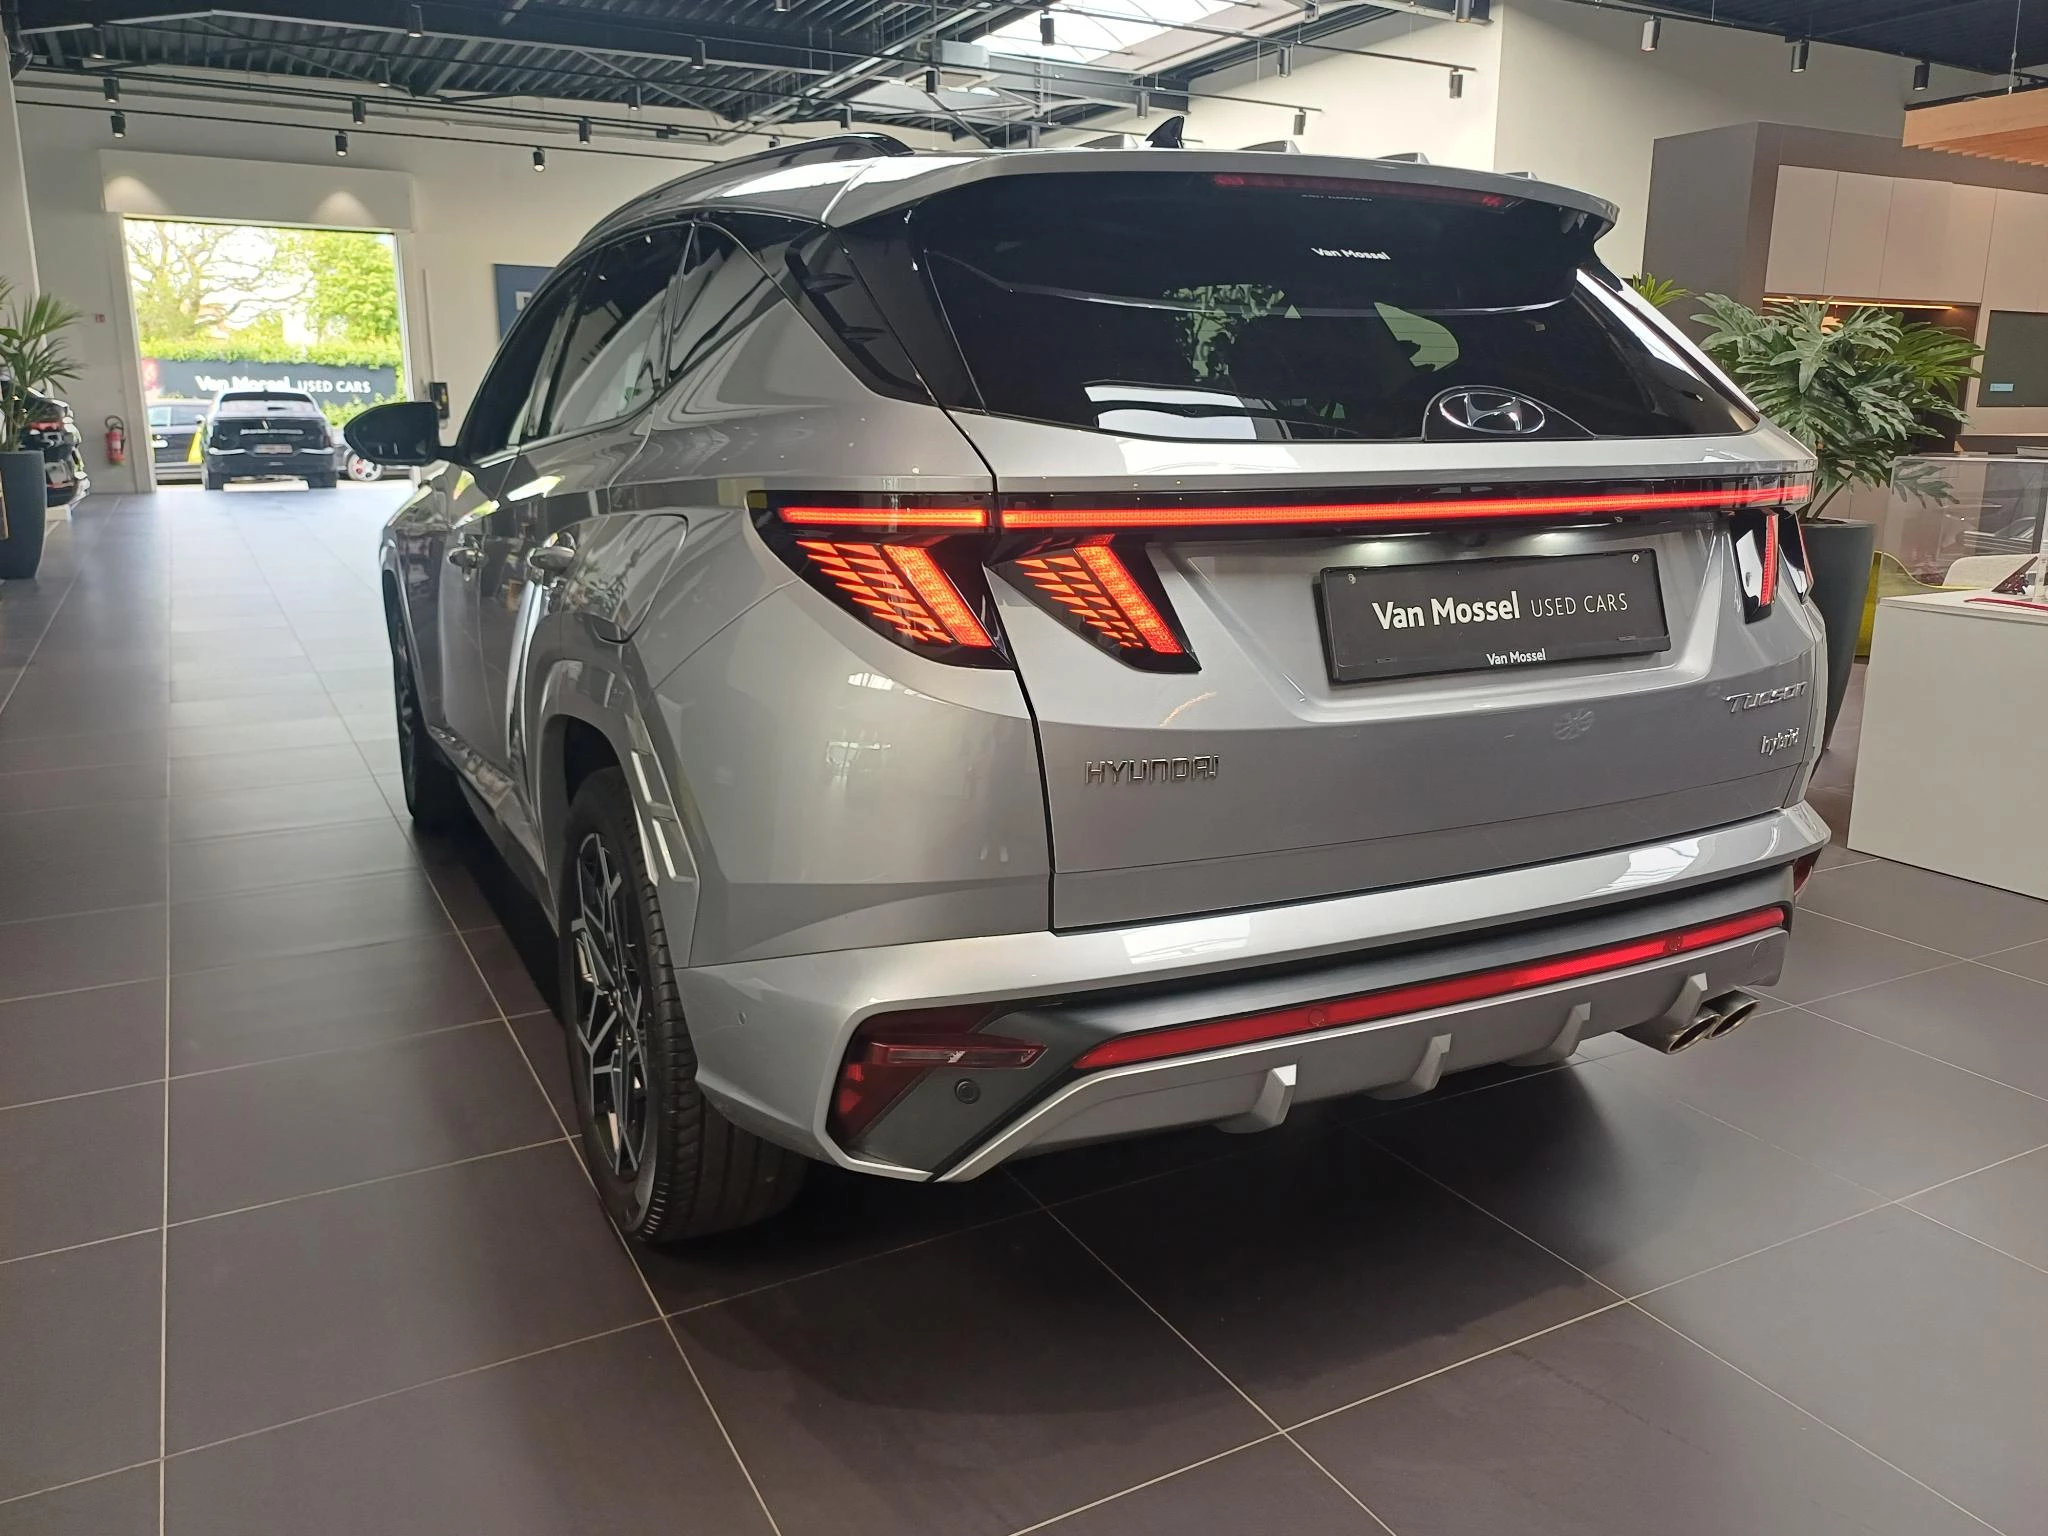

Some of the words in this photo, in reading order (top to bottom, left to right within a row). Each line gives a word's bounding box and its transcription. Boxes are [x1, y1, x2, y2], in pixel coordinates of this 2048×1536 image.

[1311, 247, 1341, 258] Van
[1341, 249, 1391, 260] Mossel
[335, 380, 371, 393] CARS
[1372, 602, 1425, 630] Van
[1430, 591, 1520, 625] Mossel
[1530, 596, 1577, 618] USED
[1583, 592, 1629, 613] CARS
[1486, 652, 1509, 666] Van
[1510, 648, 1546, 664] Mossel
[1760, 727, 1800, 756] hybrid
[1085, 753, 1220, 784] HYUNDAI
